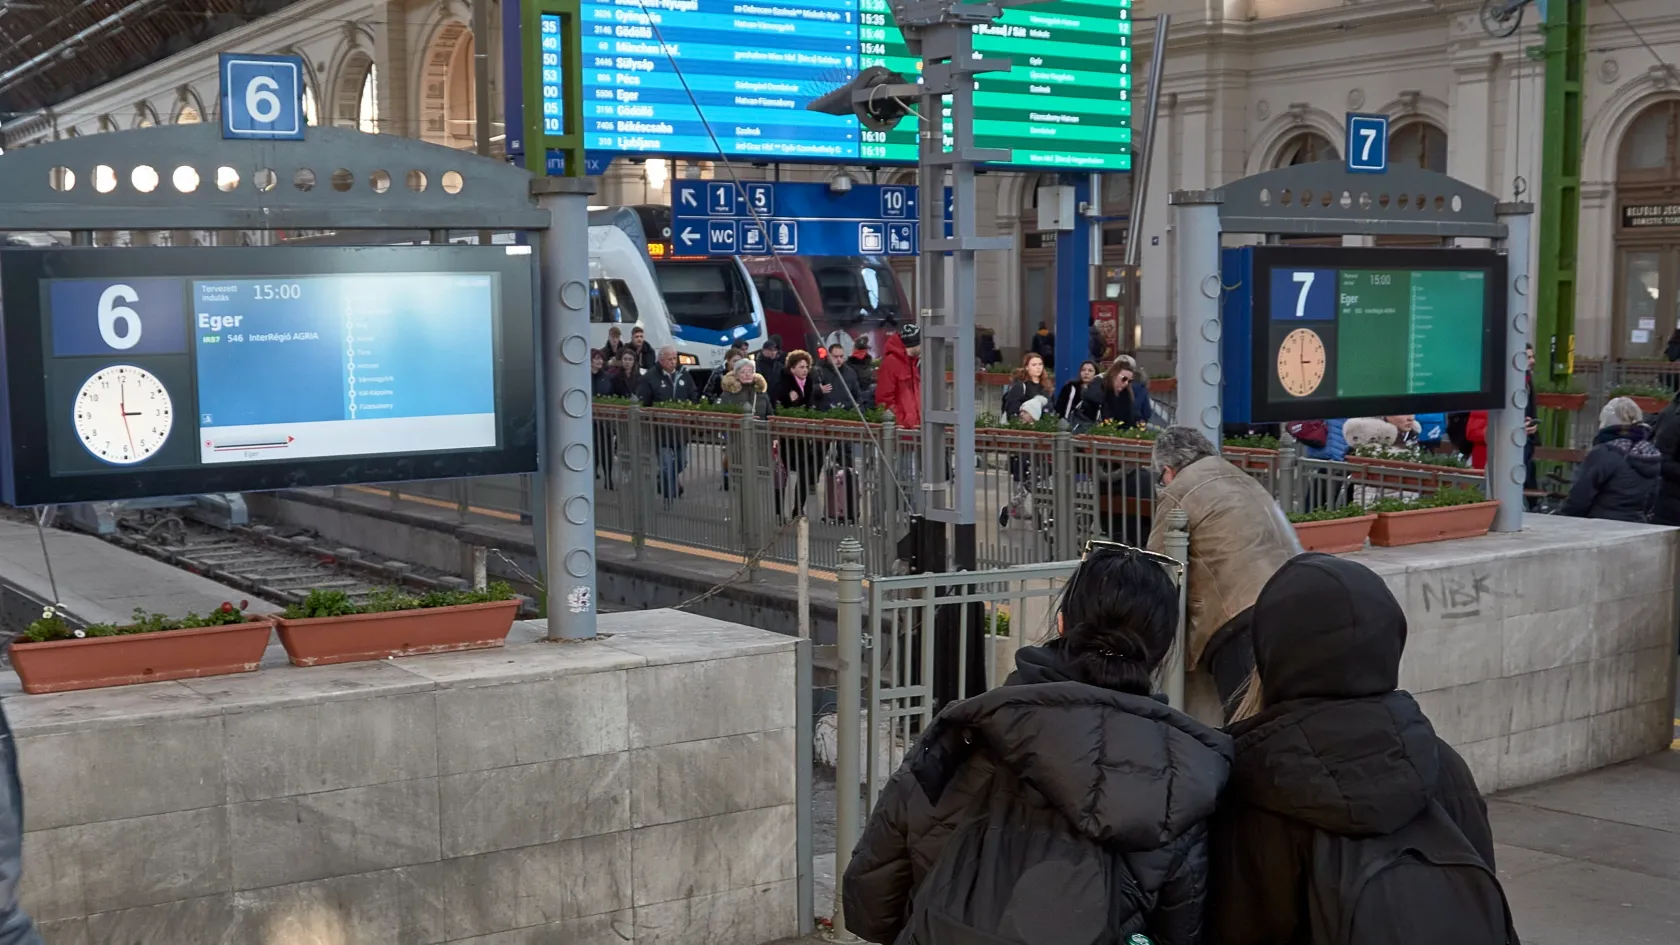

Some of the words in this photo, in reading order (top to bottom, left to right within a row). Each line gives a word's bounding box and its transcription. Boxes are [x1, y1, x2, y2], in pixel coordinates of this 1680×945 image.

[845, 12, 851, 23] 1
[861, 13, 884, 25] 15:35
[542, 21, 556, 33] 35
[615, 26, 652, 39] Gödöllő
[1118, 22, 1129, 34] 12
[861, 29, 884, 40] 15:40
[543, 38, 556, 49] 40
[1120, 37, 1126, 46] 1
[861, 43, 885, 55] 15:44
[543, 54, 557, 65] 50
[616, 57, 654, 72] Sülysáp
[1120, 63, 1127, 73] 4
[544, 70, 557, 81] 53
[544, 86, 558, 97] 00
[617, 89, 639, 103] Eger
[1120, 90, 1127, 100] 5
[246, 76, 280, 123] 6
[544, 102, 558, 113] 05
[617, 105, 653, 118] Gödöllő
[545, 118, 558, 130] 10
[617, 120, 673, 134] Békéscsaba
[862, 131, 886, 143] 16:10
[618, 137, 660, 151] Ljubljana
[1360, 129, 1376, 161] 7
[862, 146, 886, 157] 16:19
[716, 187, 725, 205] 1
[755, 188, 766, 206] 5
[884, 191, 902, 209] 10
[711, 229, 734, 243] WC
[1370, 274, 1391, 285] 15:00
[201, 285, 238, 293] Tervezett
[254, 284, 300, 300] 15:00
[1292, 272, 1315, 317] 7
[1340, 293, 1358, 306] Eger
[97, 284, 142, 350] 6
[198, 313, 243, 331] Eger
[227, 334, 244, 343] 546
[249, 332, 292, 343] InterRégió
[293, 332, 319, 341] AGRIA
[89, 394, 99, 402] 10
